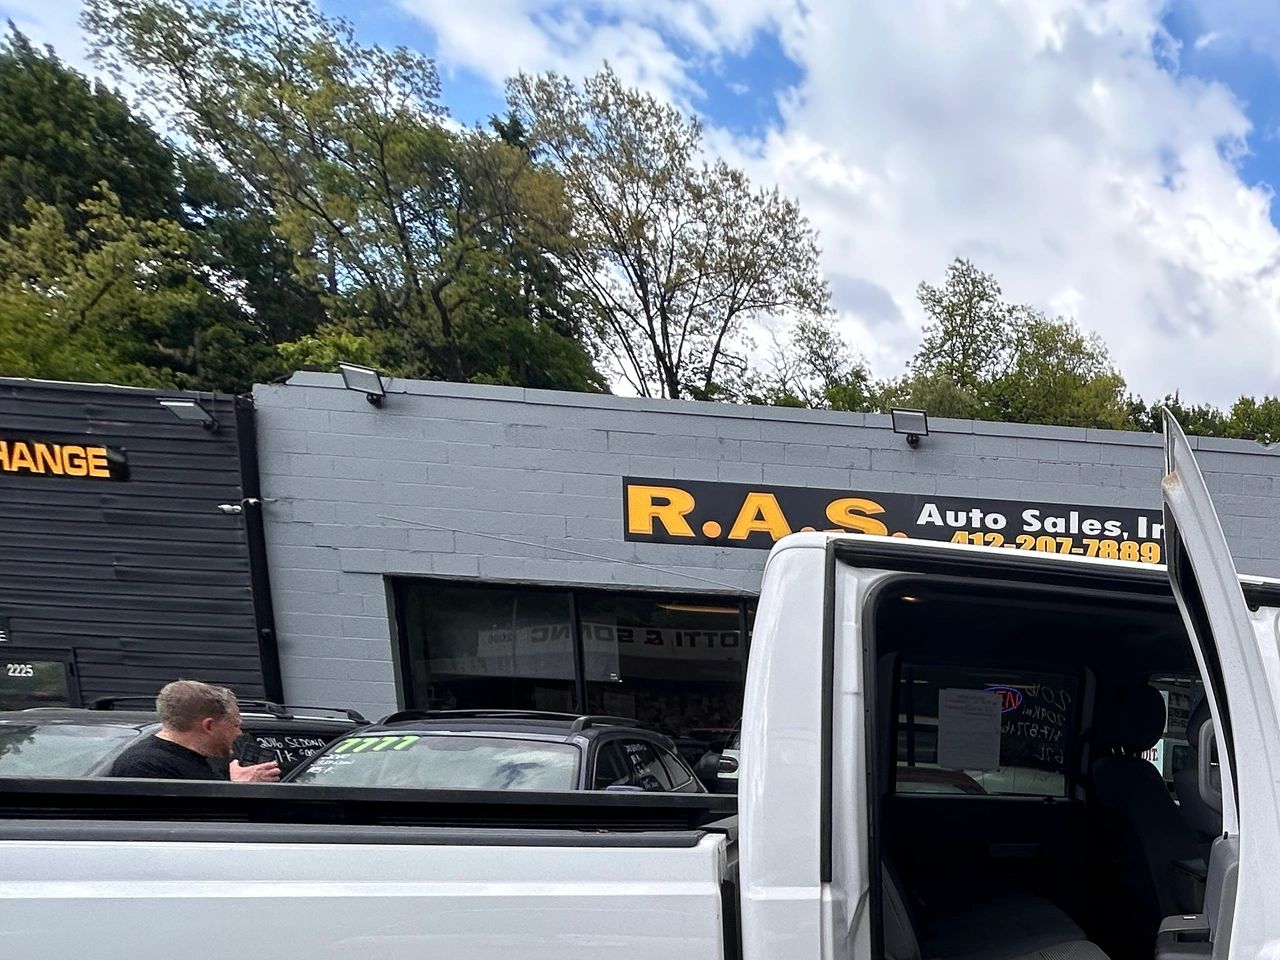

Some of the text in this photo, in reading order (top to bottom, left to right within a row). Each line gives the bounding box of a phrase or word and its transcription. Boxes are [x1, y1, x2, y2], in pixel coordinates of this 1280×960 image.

[627, 484, 909, 542] R.AS
[917, 503, 1007, 530] Auto
[1022, 509, 1129, 540] Sales,
[951, 531, 1161, 563] 412-207-7889
[6, 663, 34, 677] 2225
